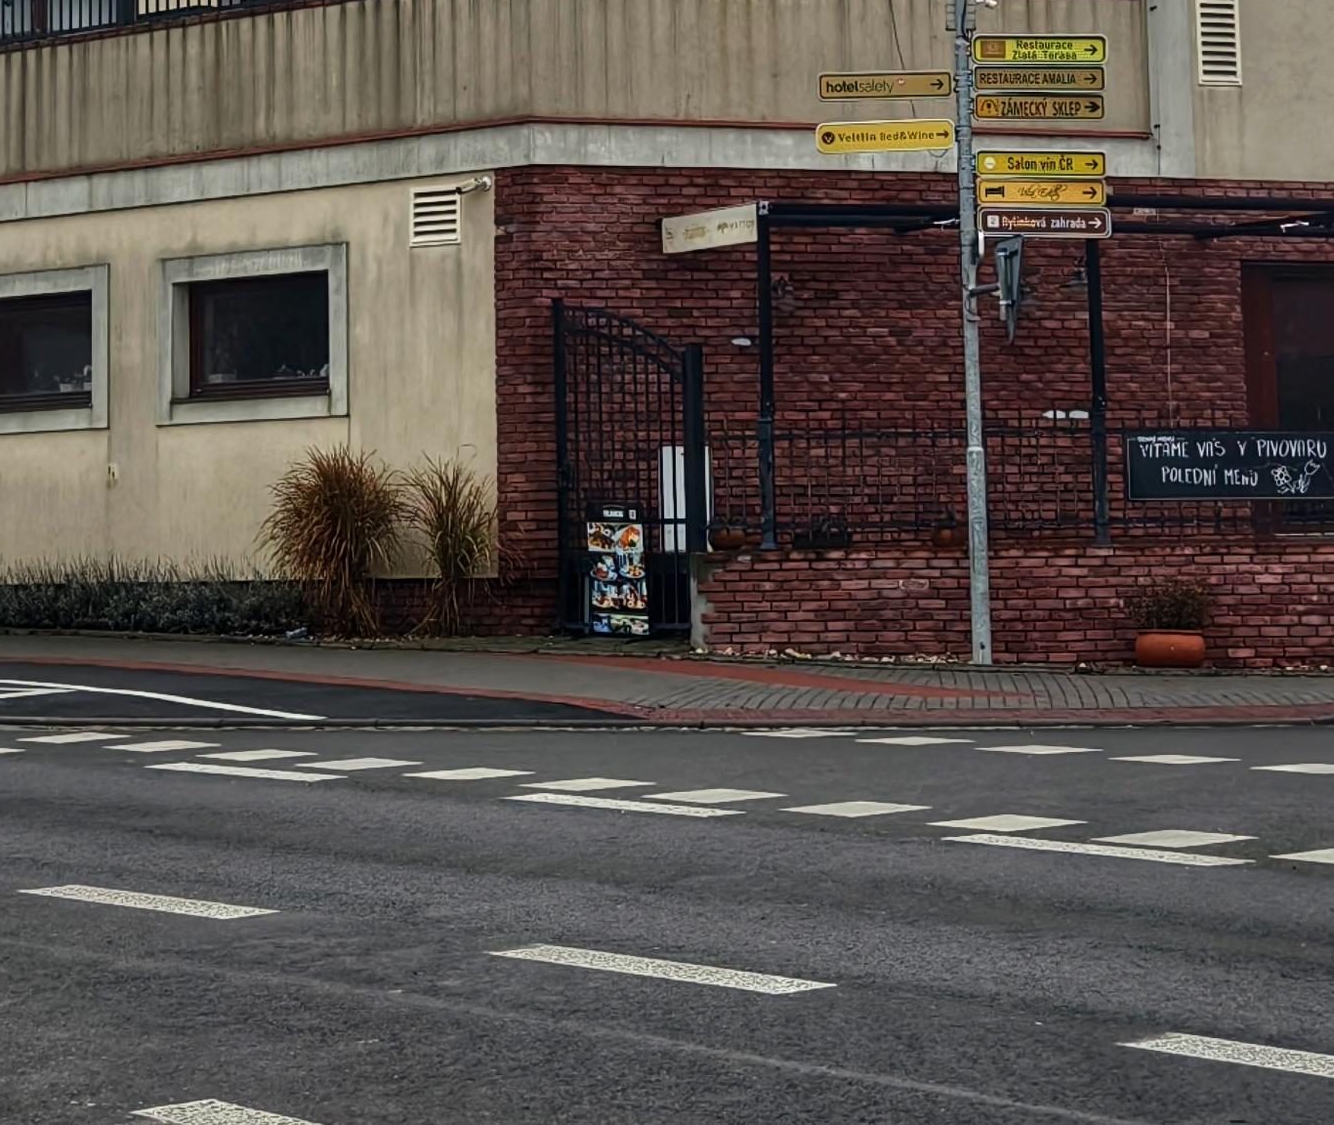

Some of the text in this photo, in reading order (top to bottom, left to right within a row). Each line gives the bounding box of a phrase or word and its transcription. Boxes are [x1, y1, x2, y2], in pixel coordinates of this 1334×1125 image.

[1015, 40, 1073, 51] Restaurace
[979, 72, 1041, 85] RESTAURACE
[1000, 98, 1082, 117] ZÁMECKÝ SKLEP
[1007, 156, 1038, 171] Salon
[1058, 154, 1074, 171] ČR
[1050, 216, 1087, 229] zahrada
[1237, 440, 1248, 458] V
[1257, 439, 1328, 459] PIVOVARU
